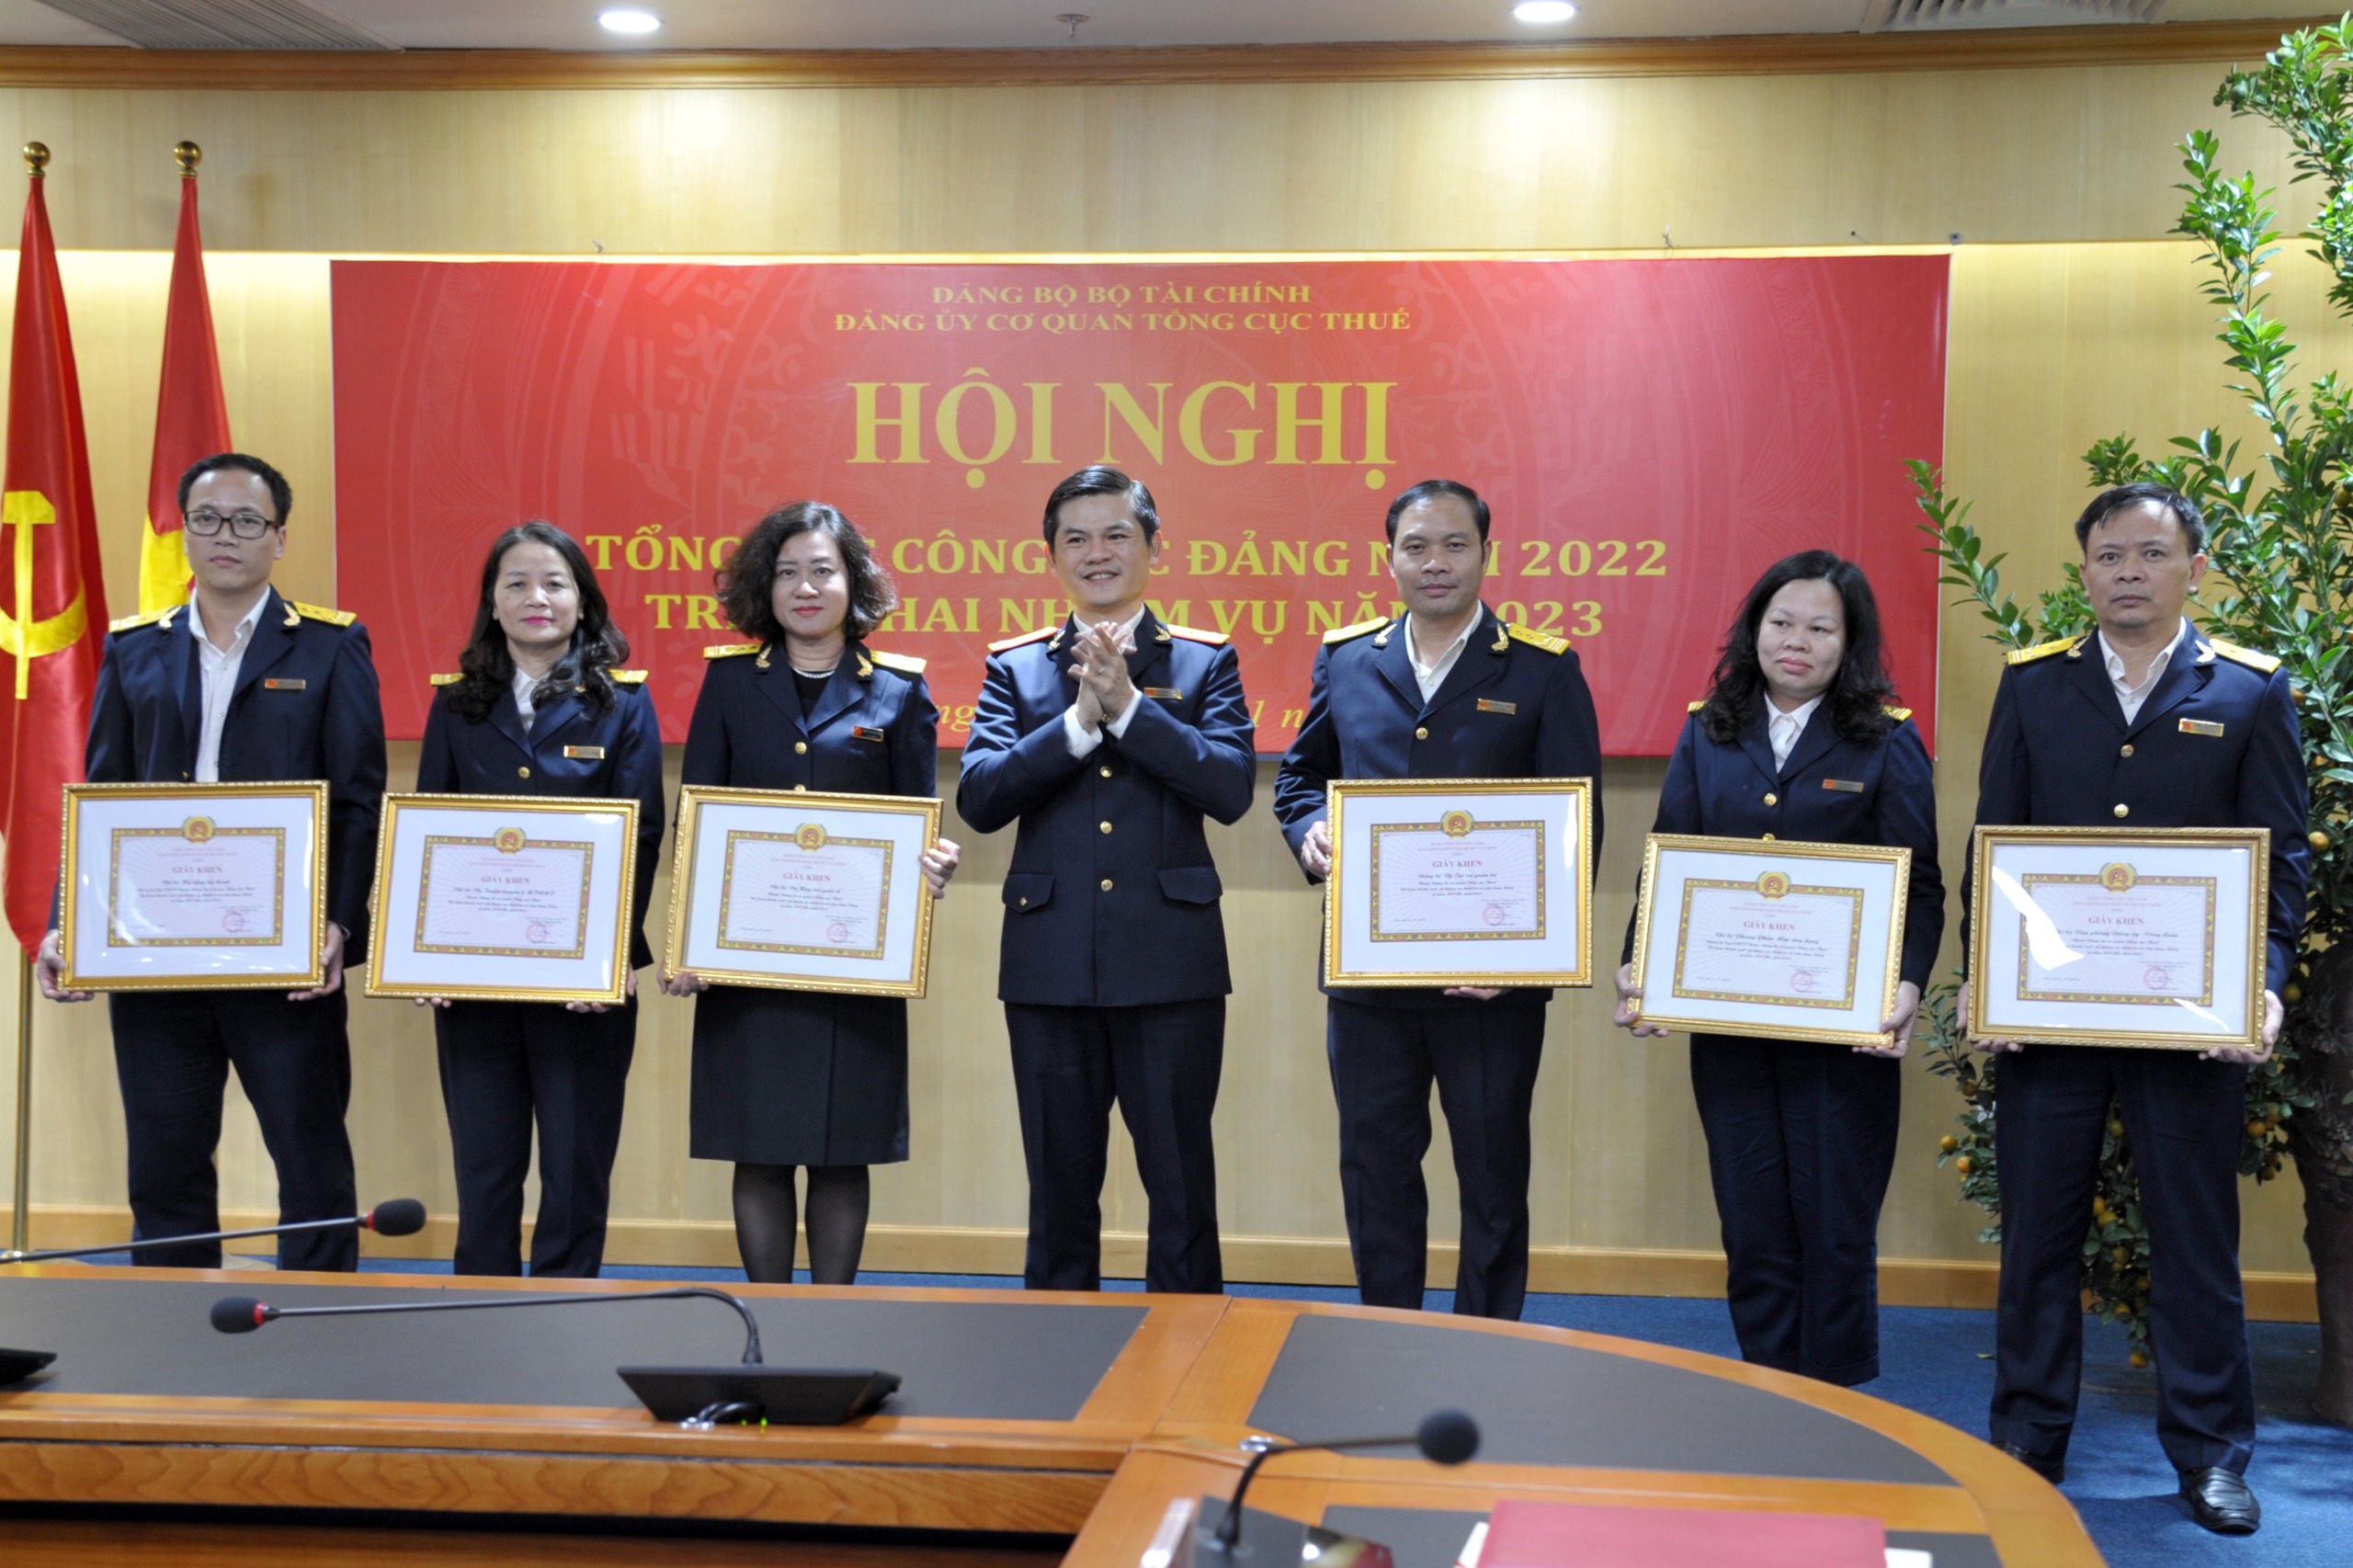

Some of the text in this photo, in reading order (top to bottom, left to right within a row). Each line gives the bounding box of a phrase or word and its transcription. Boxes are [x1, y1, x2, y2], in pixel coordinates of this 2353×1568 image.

[932, 281, 1311, 308] ĐẢNG BỘ BỘ TÀI CHÍNH
[834, 310, 926, 332] ĐẢNG
[936, 310, 979, 332] ỦY
[986, 312, 1034, 332] CƠ
[1041, 313, 1134, 335] QUAN
[1244, 312, 1313, 335] CỤC
[1321, 307, 1411, 331] THUẾ
[846, 367, 1398, 490] HỘI NGHỊ
[892, 528, 1046, 574] CÔNG
[1186, 530, 1350, 576] ĐẢNG
[1520, 540, 1667, 576] 2022
[879, 597, 980, 633] HAI
[1209, 599, 1289, 644] VỤ
[1495, 601, 1603, 637] 023
